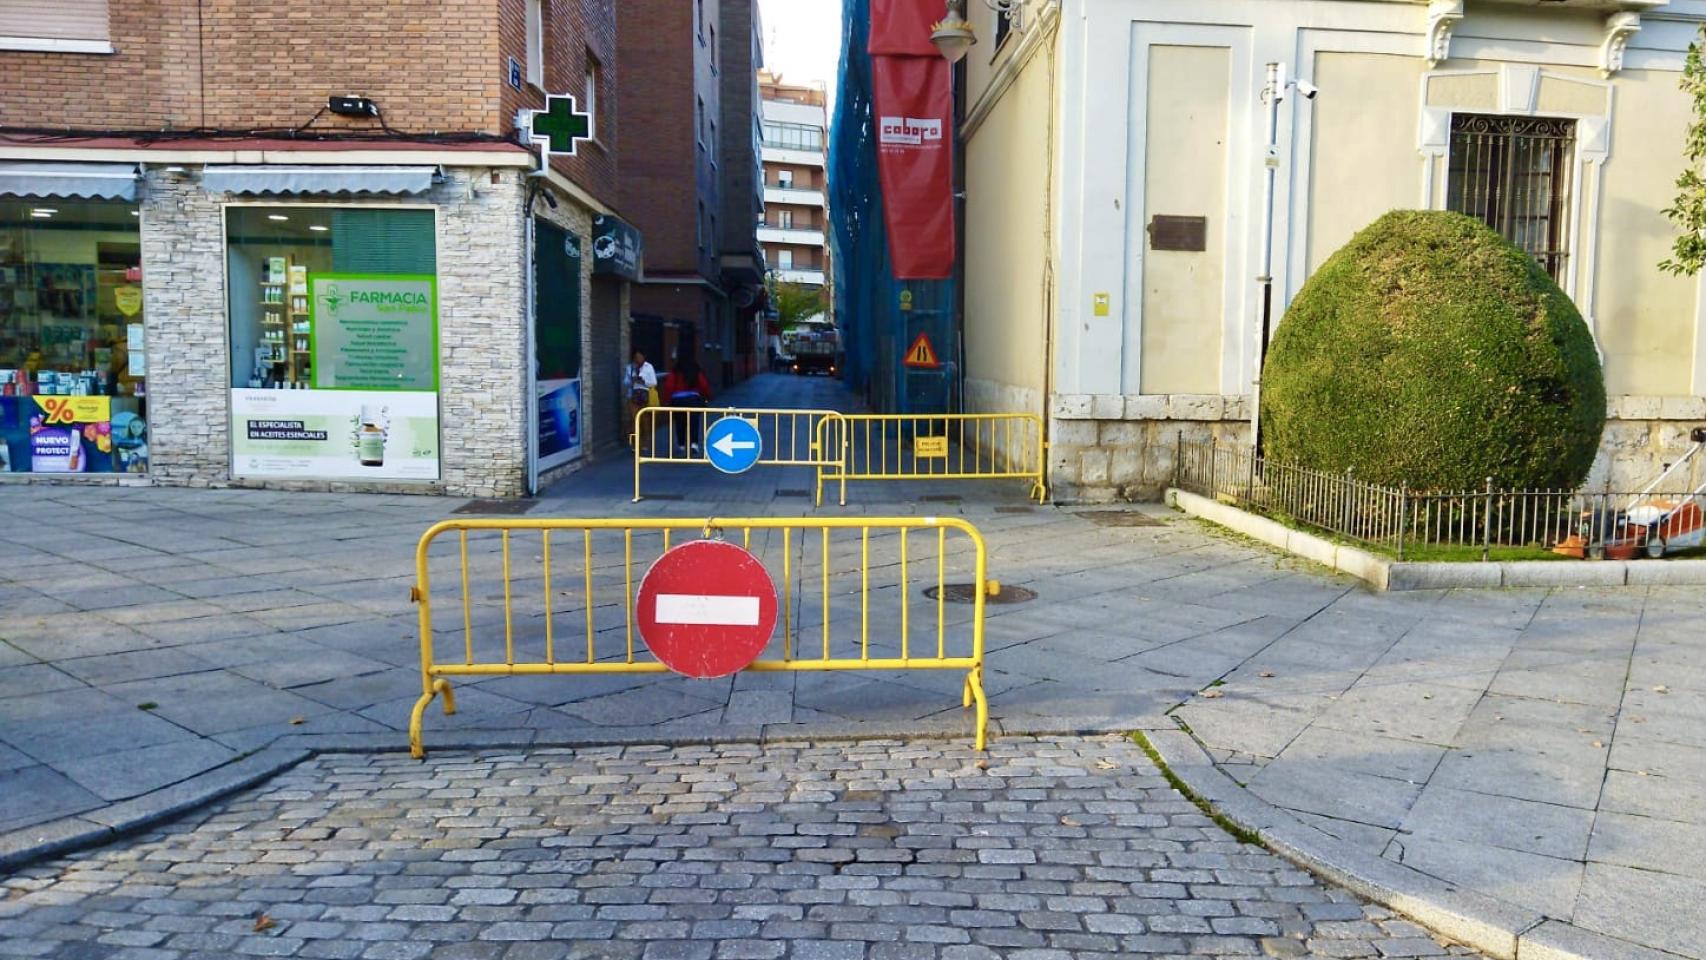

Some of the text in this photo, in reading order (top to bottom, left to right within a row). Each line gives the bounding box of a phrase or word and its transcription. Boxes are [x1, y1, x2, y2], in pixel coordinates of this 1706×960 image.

[350, 291, 427, 304] FARMACIA
[45, 398, 74, 421] %
[259, 421, 302, 429] ESPECIALISTA
[288, 431, 325, 439] ESENCIALES
[36, 447, 69, 455] PROTECT
